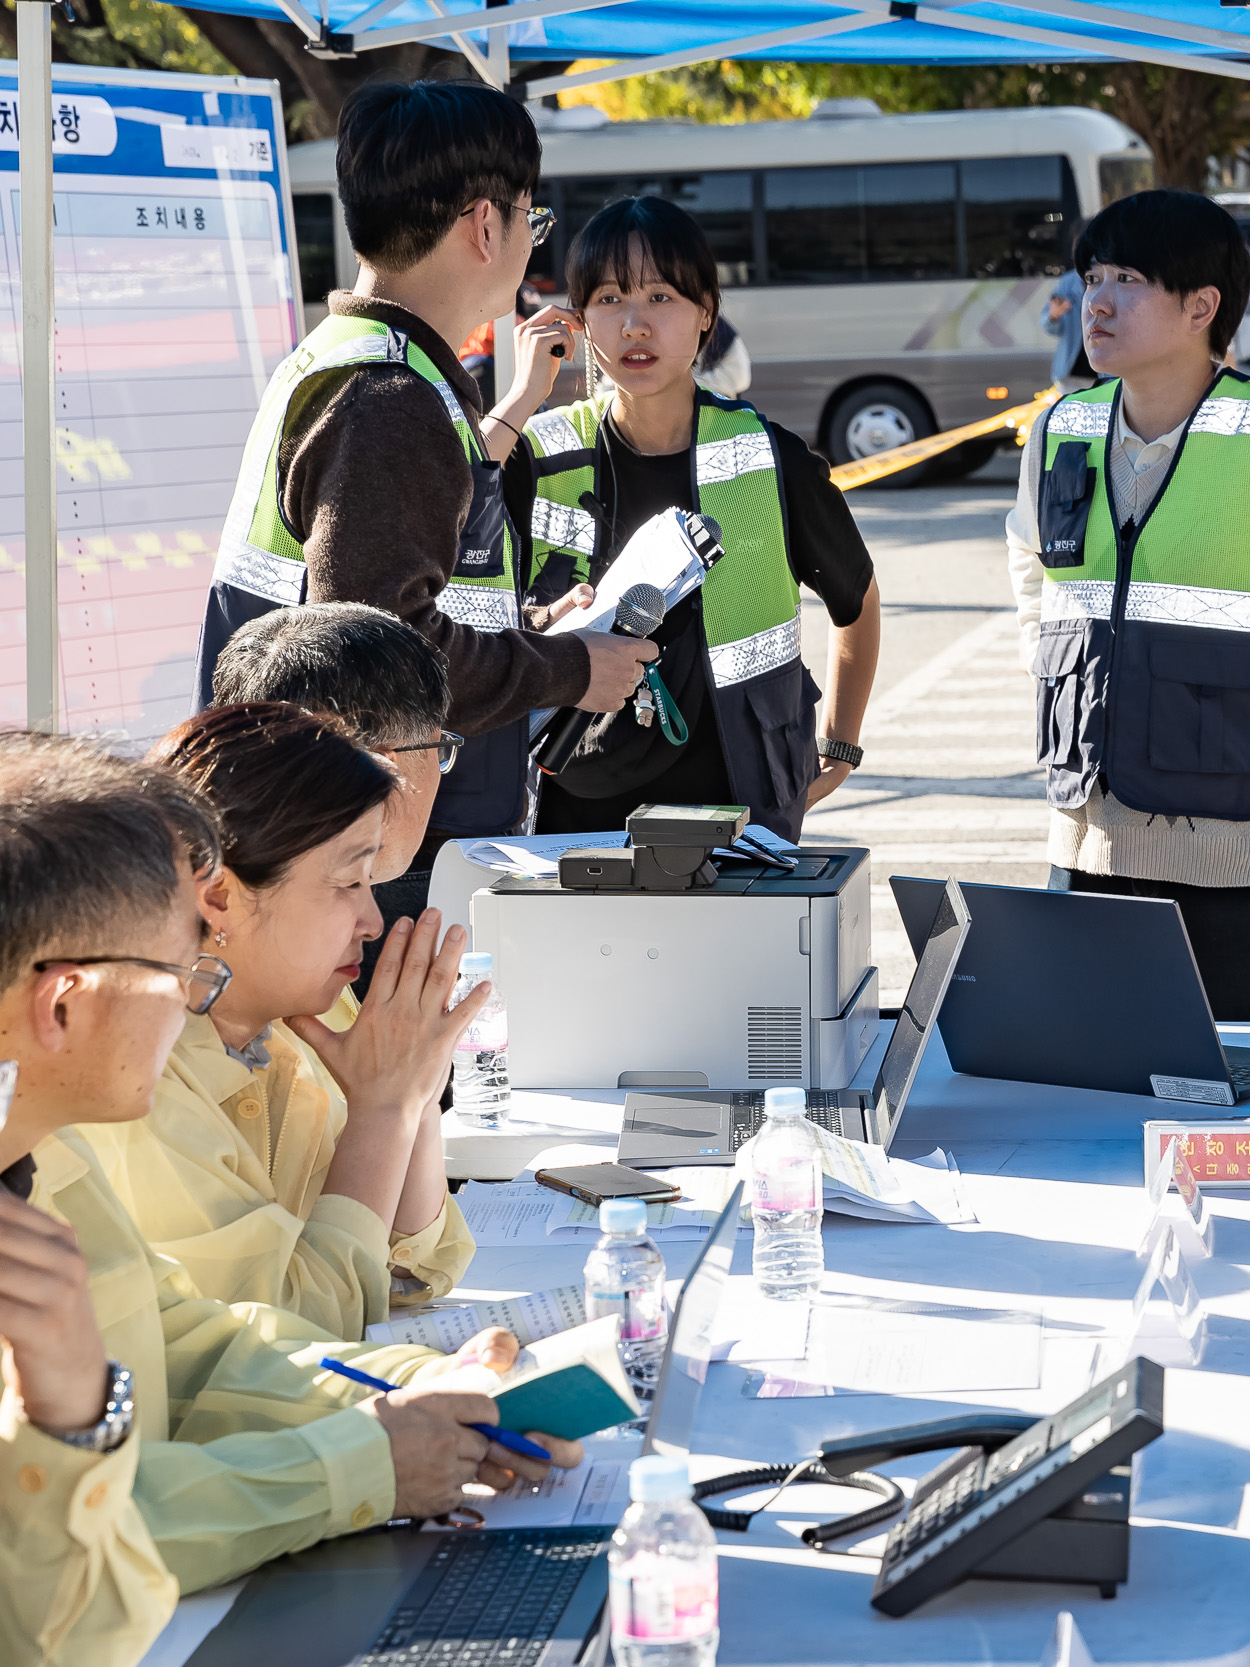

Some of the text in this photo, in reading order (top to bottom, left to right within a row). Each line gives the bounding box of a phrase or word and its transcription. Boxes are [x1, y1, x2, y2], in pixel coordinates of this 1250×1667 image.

[136, 205, 207, 231] 조치내용
[1055, 540, 1076, 550] 광진구
[465, 549, 490, 560] 광진구
[653, 688, 667, 725] STARBUCKS
